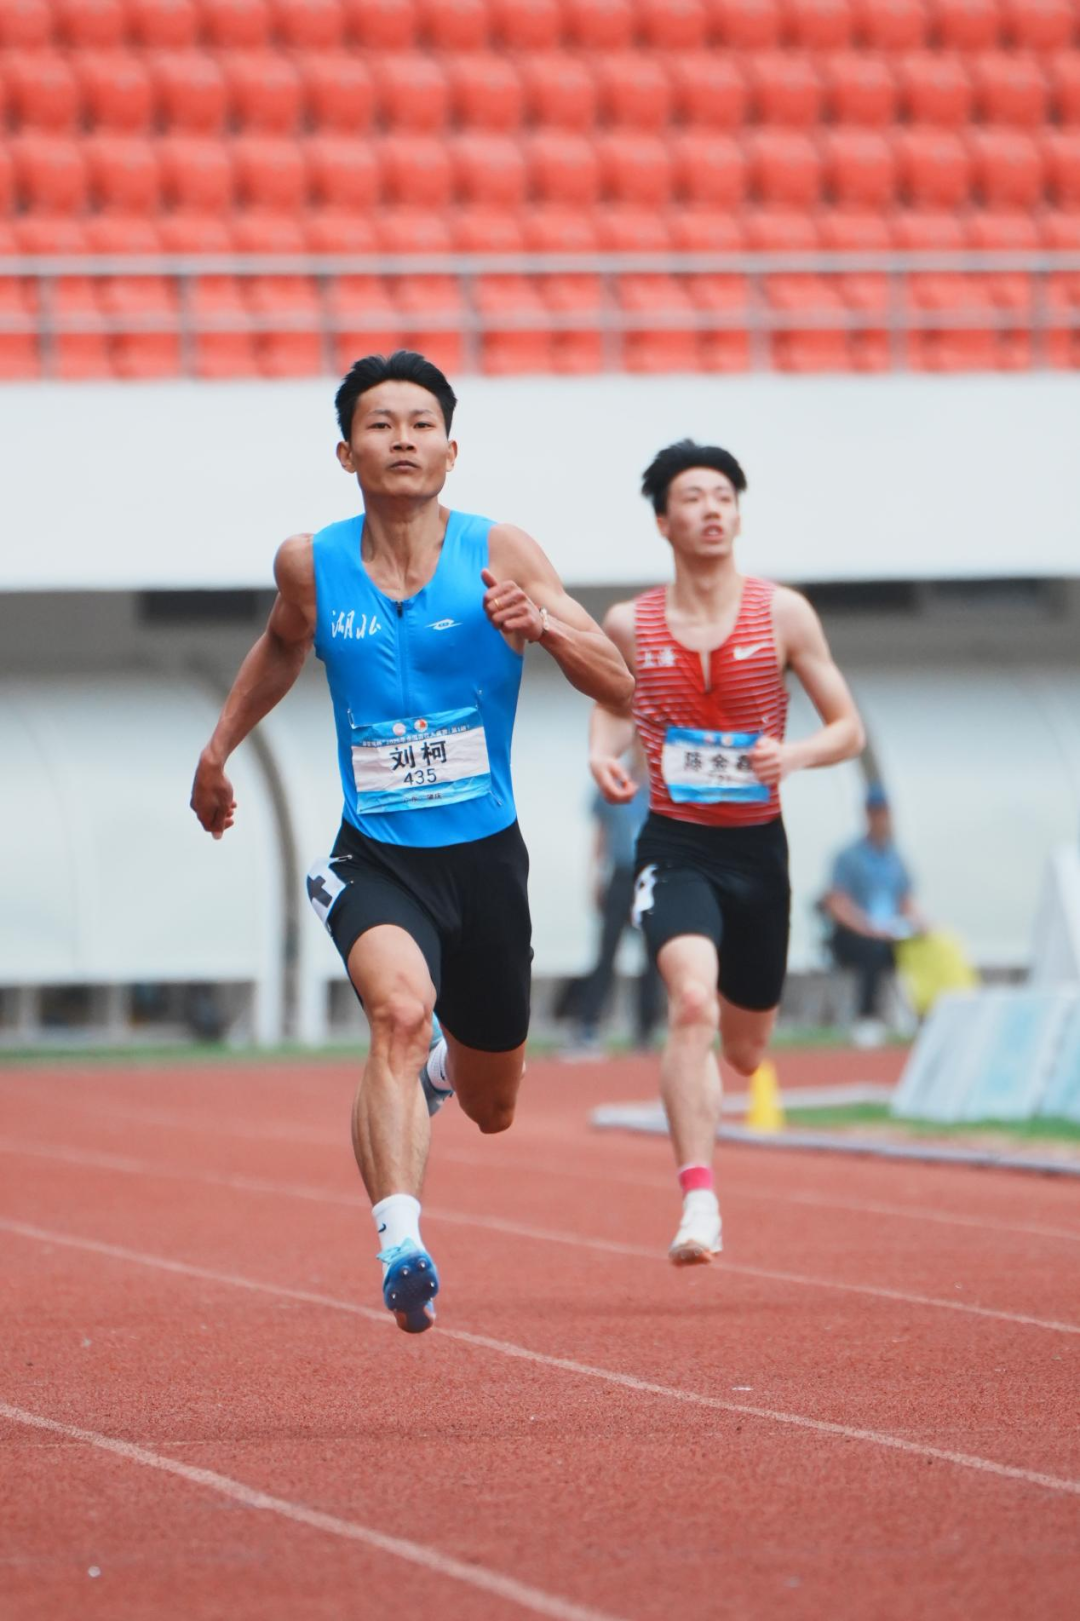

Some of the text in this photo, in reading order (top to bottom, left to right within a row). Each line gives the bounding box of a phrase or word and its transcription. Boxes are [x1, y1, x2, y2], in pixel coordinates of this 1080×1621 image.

[331, 609, 381, 639] 湖北
[389, 740, 448, 770] 刘柯
[403, 768, 438, 785] 435
